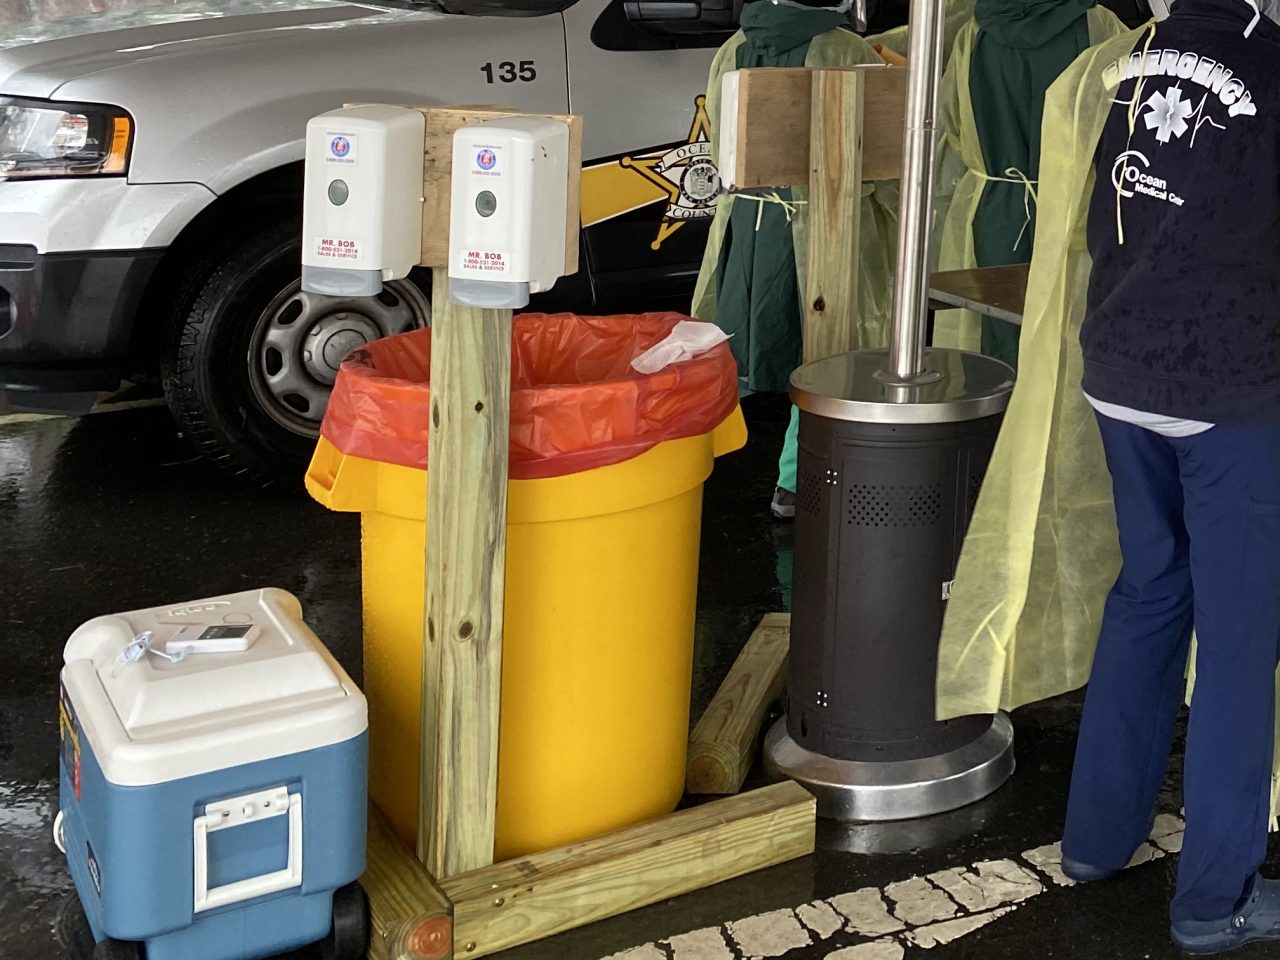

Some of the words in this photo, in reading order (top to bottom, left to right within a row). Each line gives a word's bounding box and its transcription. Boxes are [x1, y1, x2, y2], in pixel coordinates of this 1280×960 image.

[480, 60, 537, 84] 135
[1102, 49, 1257, 118] EMERGENCY
[676, 143, 711, 158] OCE
[1125, 166, 1167, 190] Ocean
[1134, 183, 1168, 201] Medical
[672, 207, 716, 219] COUN
[321, 239, 336, 247] MR.
[338, 240, 355, 248] BOB
[468, 251, 482, 259] MR.
[484, 252, 502, 260] BOB
